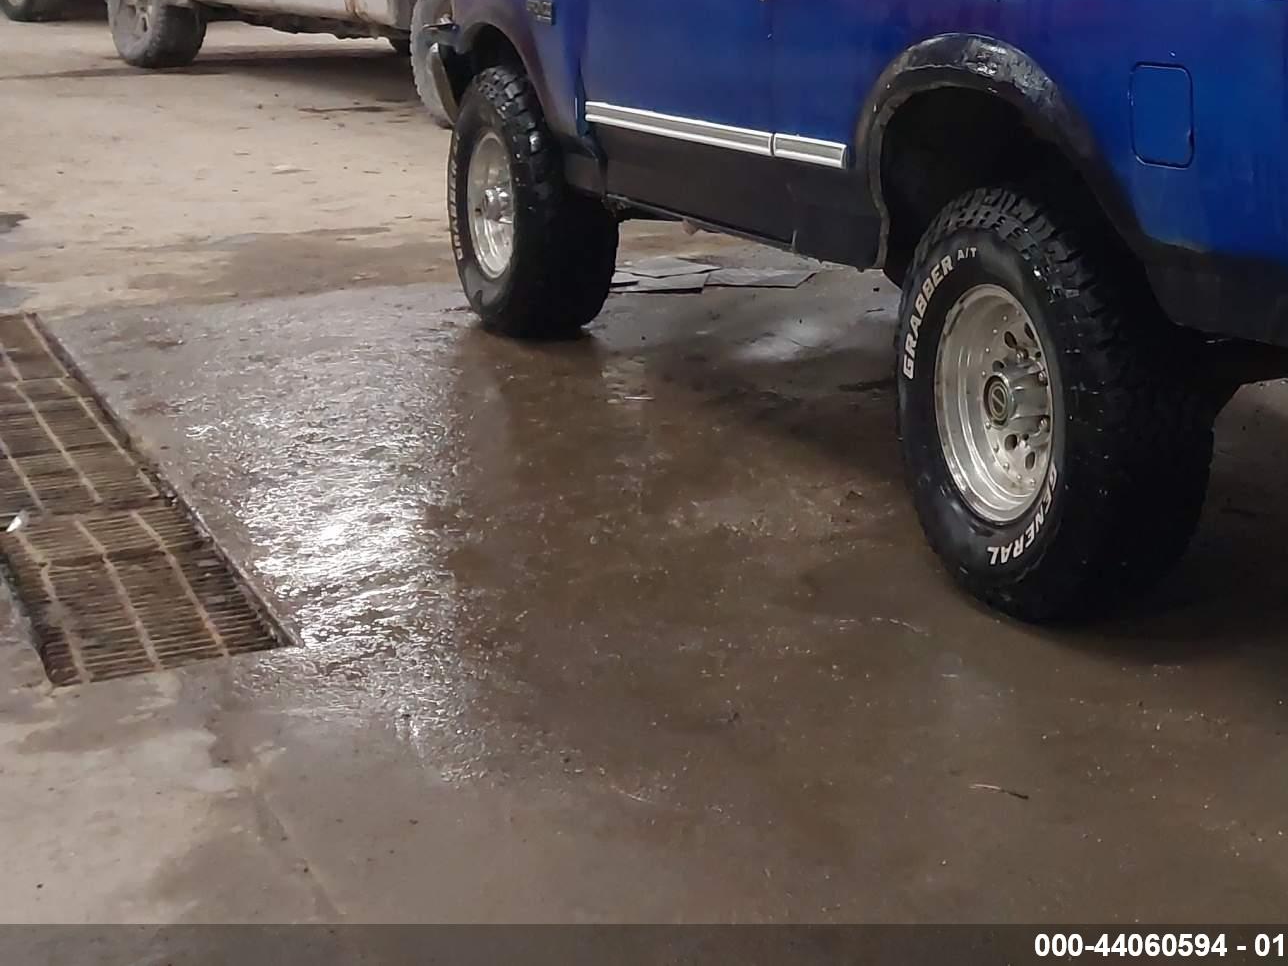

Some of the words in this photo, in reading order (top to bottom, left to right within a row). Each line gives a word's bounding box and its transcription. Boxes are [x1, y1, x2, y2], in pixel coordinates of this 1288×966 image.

[903, 255, 954, 380] GRABBER
[957, 247, 977, 261] A/T
[987, 461, 1057, 565] GENERAL
